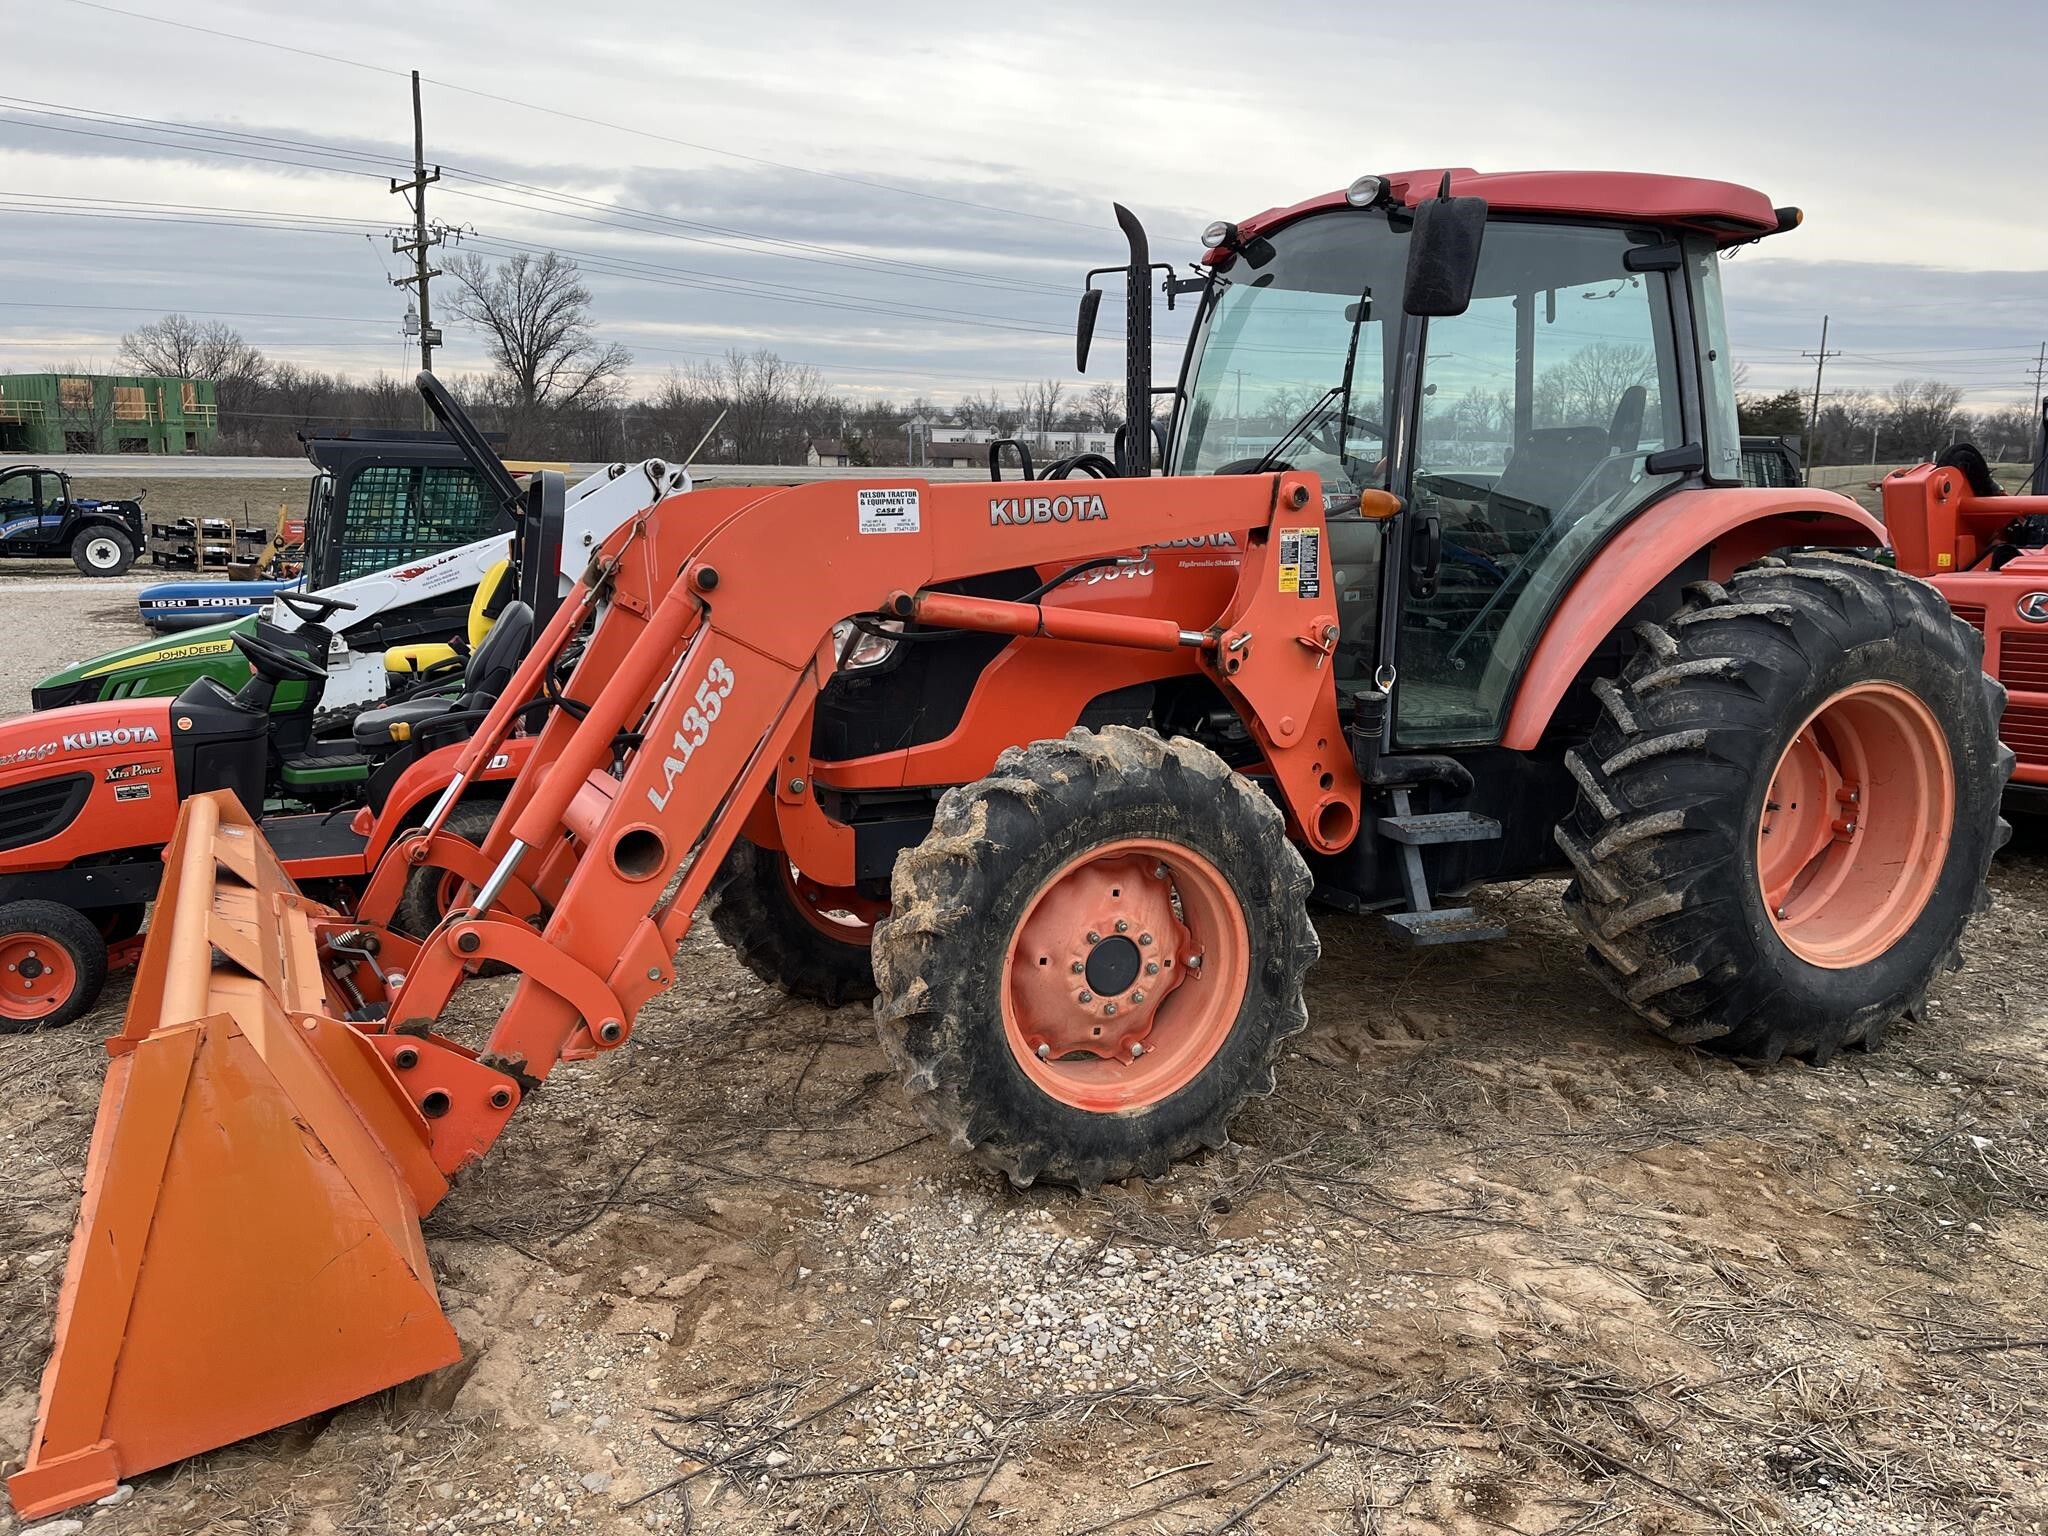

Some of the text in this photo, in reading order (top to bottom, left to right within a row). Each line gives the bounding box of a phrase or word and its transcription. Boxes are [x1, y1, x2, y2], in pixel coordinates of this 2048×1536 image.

[860, 490, 917, 499] NELSON TRACTOR
[860, 497, 917, 506] & EQUIPMENT CO.
[990, 494, 1108, 525] KUBOTA
[1178, 559, 1241, 568] Hydraulic Shuttle
[152, 598, 251, 608] 1620 FORD
[155, 644, 228, 661] JOHN DEERE
[62, 726, 159, 751] KUBOTA
[647, 657, 735, 813] LA1353
[105, 764, 162, 780] Xtra Power
